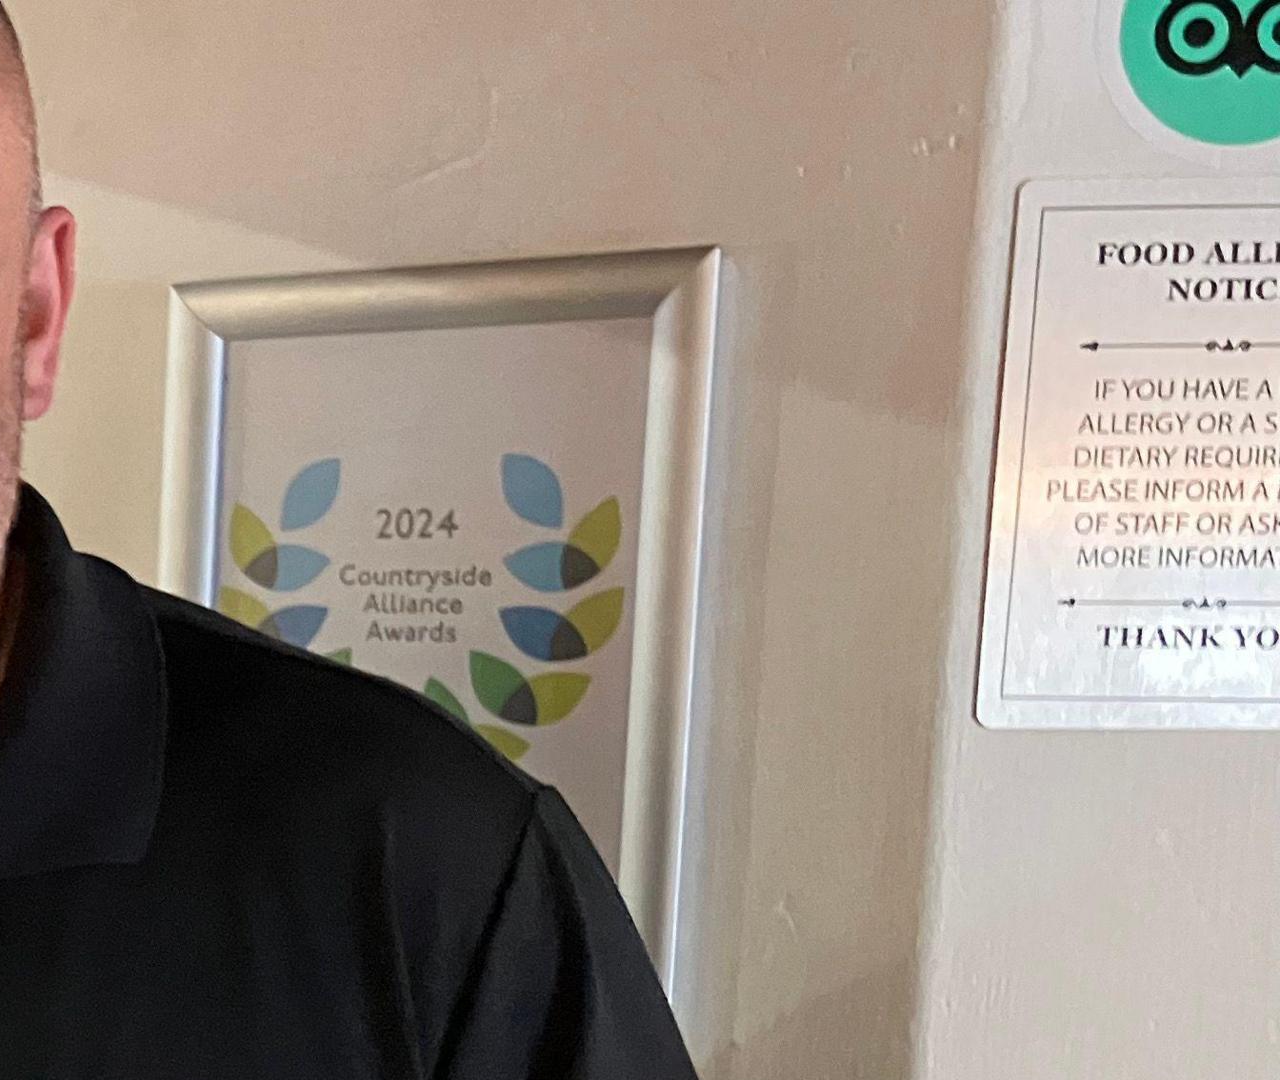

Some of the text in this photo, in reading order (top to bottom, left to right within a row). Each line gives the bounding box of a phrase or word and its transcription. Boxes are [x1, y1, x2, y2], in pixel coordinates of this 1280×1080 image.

[1098, 241, 1280, 266] FOOD ALL
[1168, 278, 1278, 302] NOTIC
[1095, 378, 1272, 401] IF YOU HAVE A
[1078, 411, 1280, 436] ALLERGY OR A S
[1074, 445, 1280, 468] DIETARY REQUIR
[1046, 479, 1269, 502] PLEASE INFORM A
[376, 508, 459, 540] 2024
[1074, 512, 1109, 536] OF
[1115, 512, 1189, 535] STAFF
[1196, 512, 1232, 535] OR
[1077, 545, 1280, 568] MORE INFORMA
[340, 564, 492, 594] Countryside
[362, 593, 464, 616] Alliance
[366, 621, 457, 644] Awards
[1097, 624, 1280, 649] THANK YO
